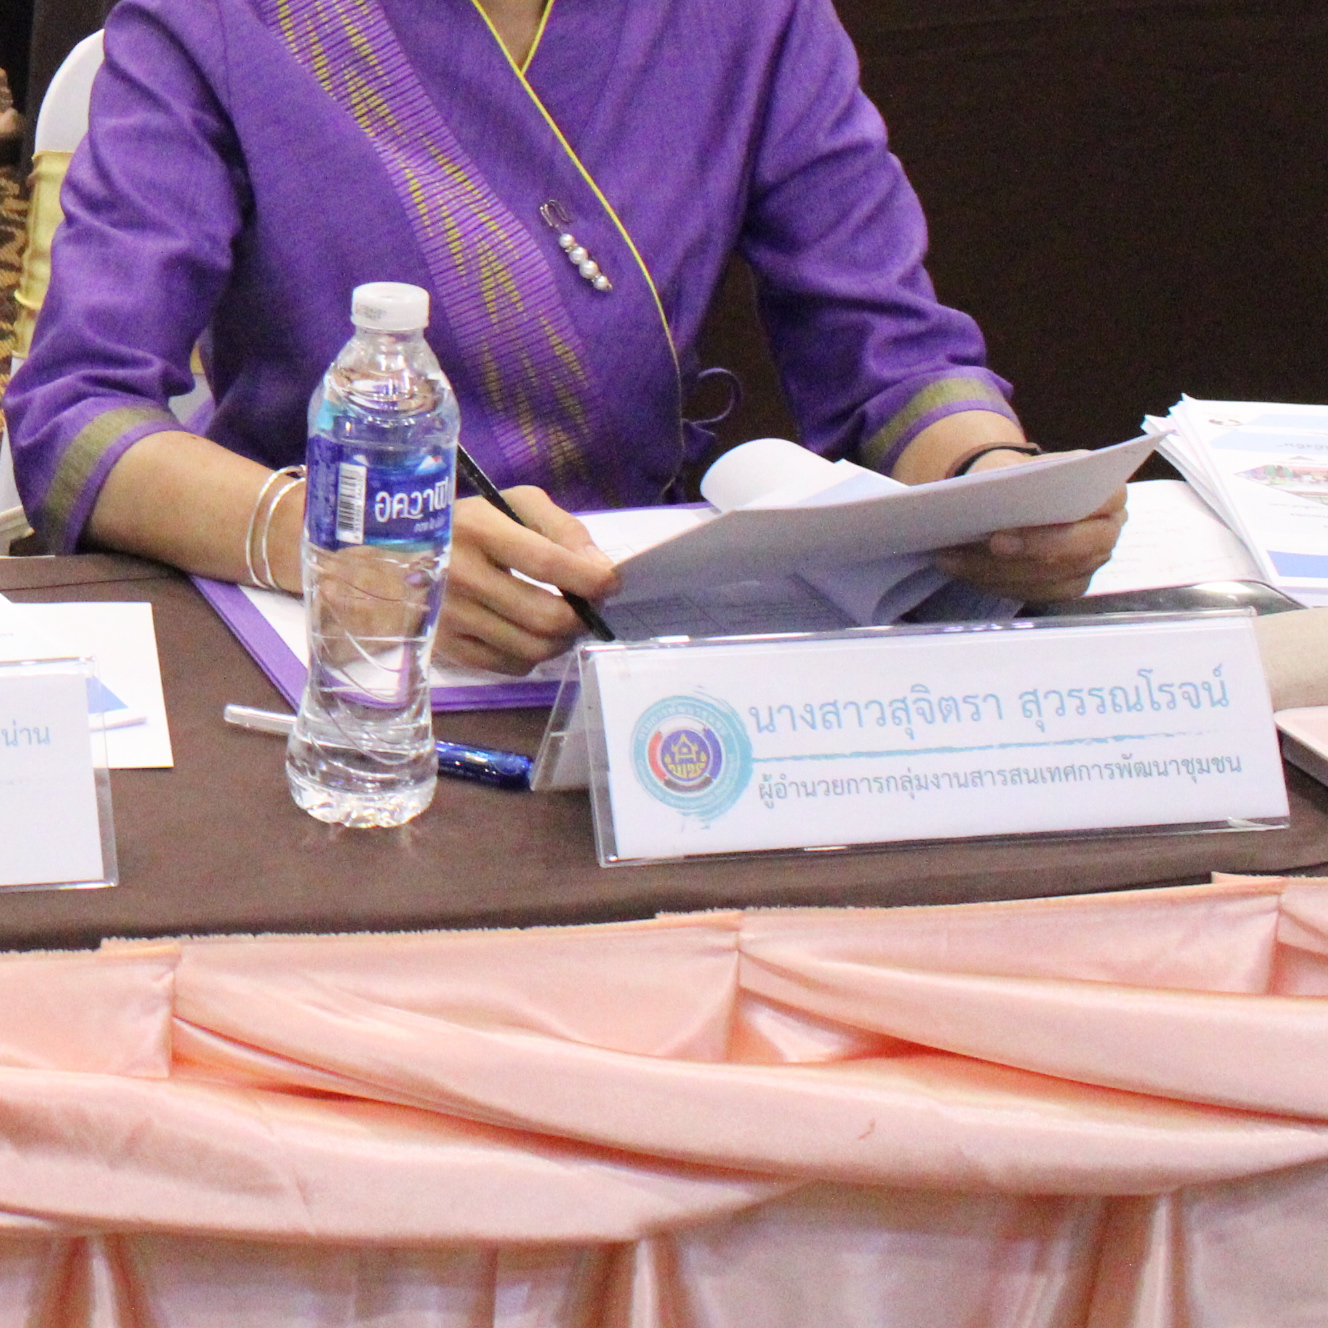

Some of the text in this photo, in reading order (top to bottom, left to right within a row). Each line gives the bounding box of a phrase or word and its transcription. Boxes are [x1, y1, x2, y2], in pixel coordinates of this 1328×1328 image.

[750, 663, 1230, 740] นางสาวสุจิตรา สุวรรณโรจน์
[758, 752, 1243, 808] ผู้อำนวยการกลุ่มงานสารสนเทศการพัฒนาชุมชน
